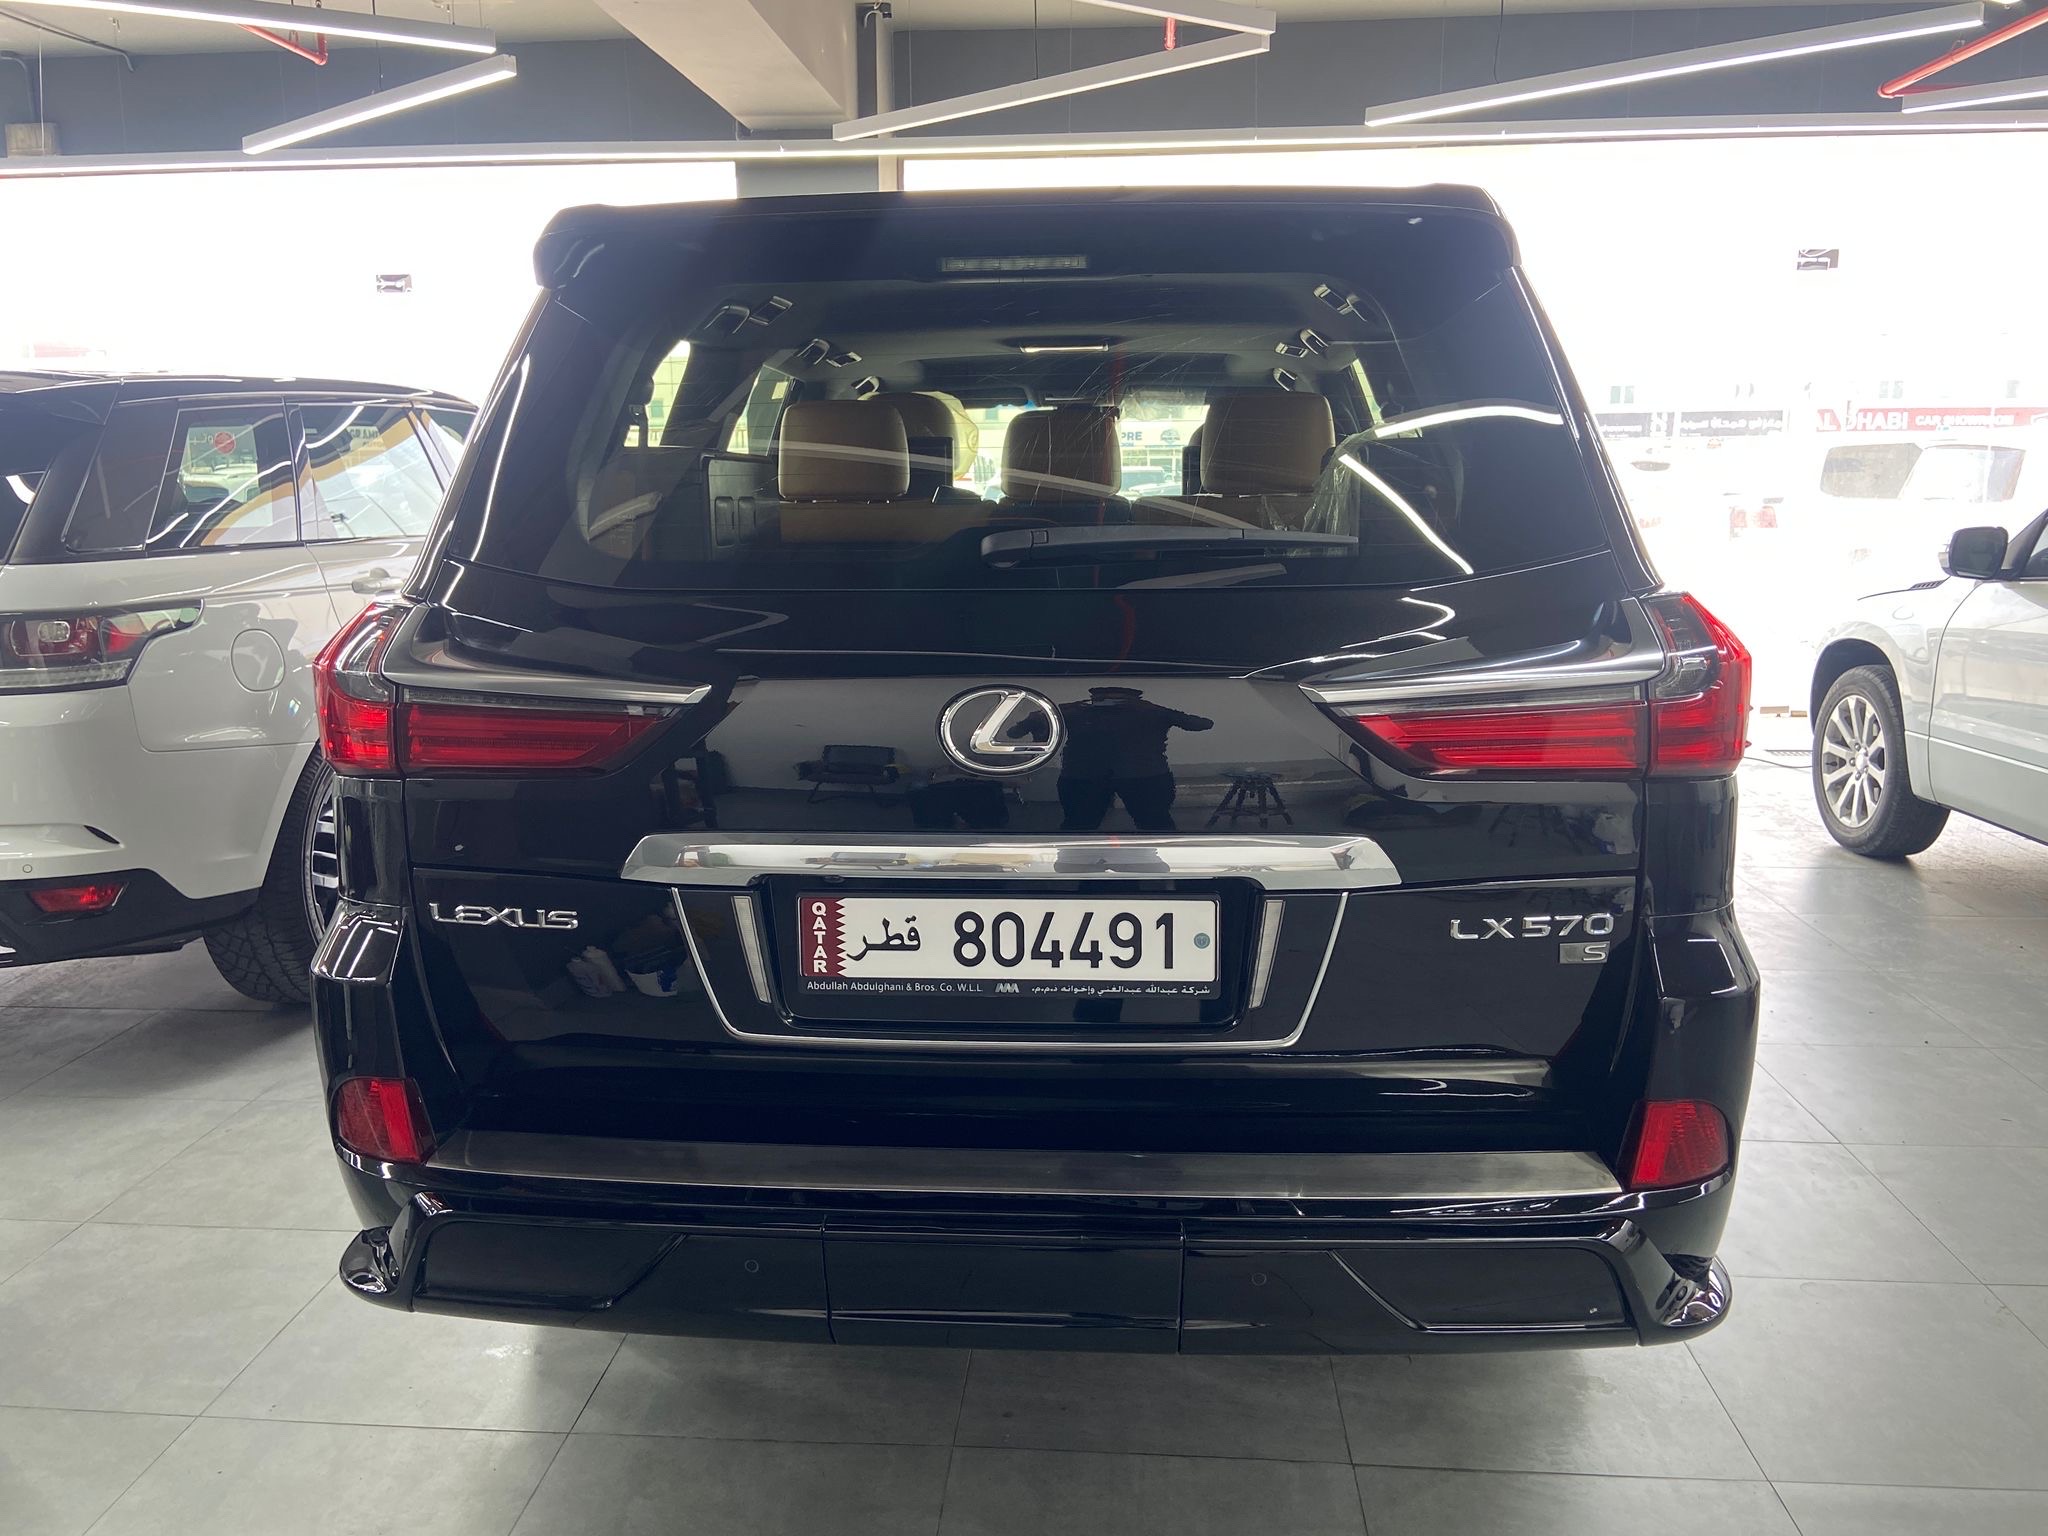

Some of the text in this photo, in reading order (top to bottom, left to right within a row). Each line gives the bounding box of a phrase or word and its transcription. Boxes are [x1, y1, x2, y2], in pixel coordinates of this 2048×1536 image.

[428, 902, 579, 930] LEXUS
[1450, 912, 1615, 940] LX 570
[811, 901, 829, 973] QATAR
[846, 915, 921, 962] قطر
[953, 910, 1174, 970] 804491
[806, 981, 848, 991] Abdullah
[850, 982, 904, 993] Abdulghani
[905, 983, 913, 992] &
[914, 983, 938, 993] Bros.
[939, 983, 955, 993] Co.
[1097, 985, 1142, 996] عبدالغني
[1145, 984, 1178, 995] عبدالله
[1181, 985, 1211, 995] شركة
